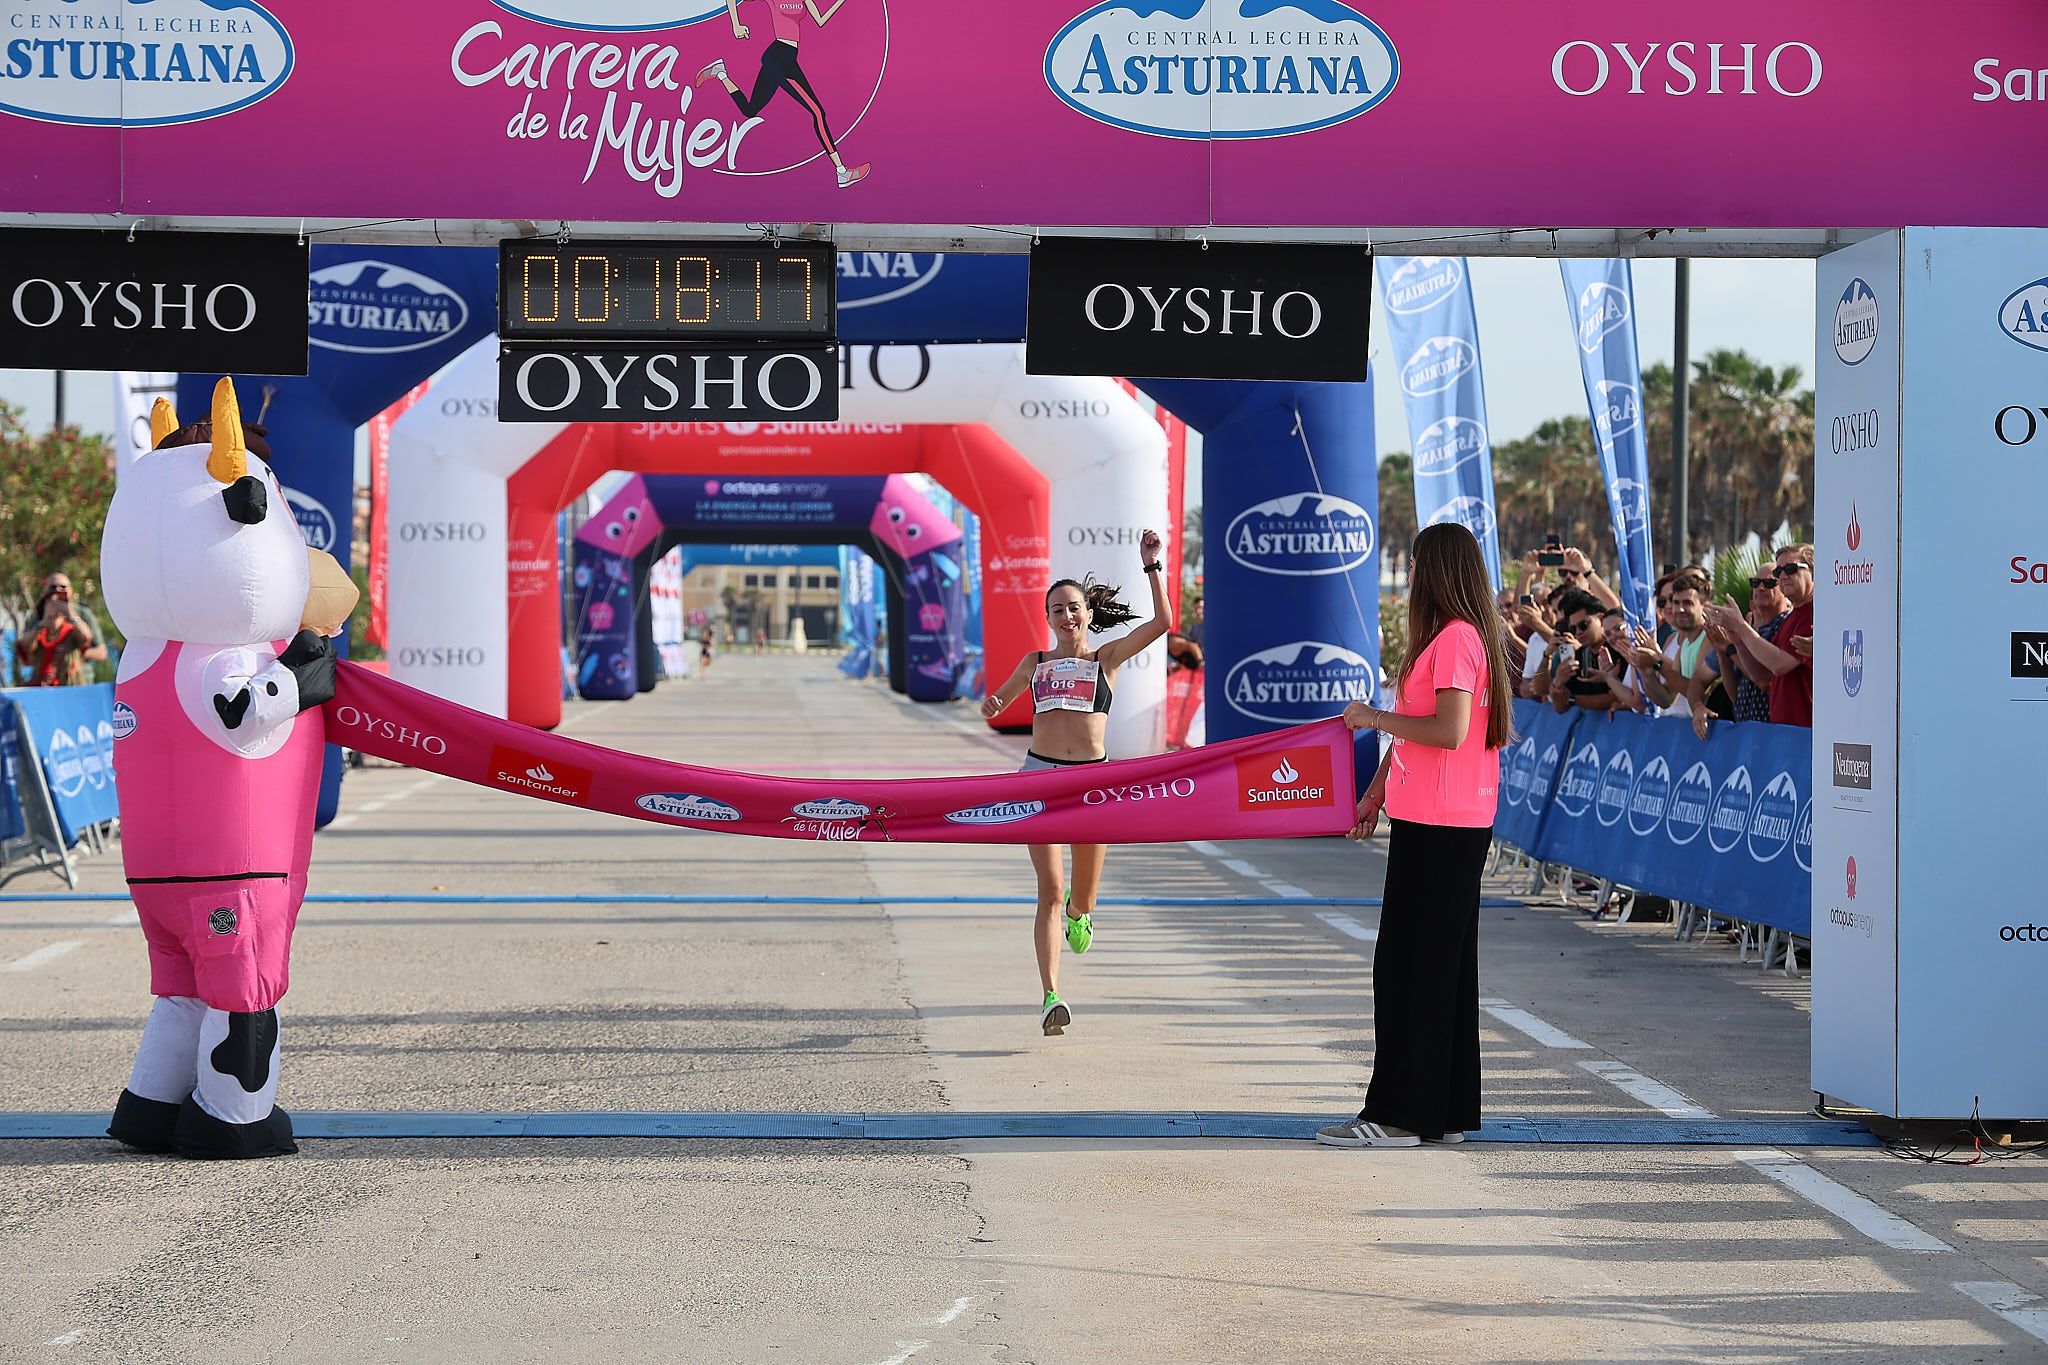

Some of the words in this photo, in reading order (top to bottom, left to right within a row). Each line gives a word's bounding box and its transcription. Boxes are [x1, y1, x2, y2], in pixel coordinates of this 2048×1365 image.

[10, 13, 124, 31] CENTRAL
[138, 17, 253, 34] LECHERA
[1127, 30, 1238, 46] CENTRAL
[1249, 30, 1361, 46] LECHERA
[0, 37, 266, 84] STURIANA
[450, 20, 680, 91] Carrera
[1071, 33, 1373, 95] ASTURIANA
[1551, 40, 1823, 96] OYSHO
[506, 92, 549, 140] de
[558, 91, 589, 141] la
[581, 87, 765, 198] Mujer
[522, 255, 812, 323] 00:18:17
[12, 278, 258, 333] OYSHO
[309, 301, 450, 333] STURIANA
[1084, 283, 1322, 339] OYSHO
[1836, 315, 1876, 347] ASTURIANA
[515, 352, 822, 412] OYSHO
[1020, 400, 1110, 419] OYSHO
[1831, 409, 1879, 455] OYSHO
[400, 522, 487, 543] OYSHO
[1068, 526, 1144, 546] OYSH
[1236, 523, 1368, 555] ASTURIANA
[1834, 557, 1874, 587] Santander
[399, 646, 486, 668] OYSHO
[1051, 680, 1076, 689] 016
[1235, 671, 1367, 703] ASTURIANA
[336, 705, 447, 755] OYSHO
[1835, 751, 1869, 784] Neutrogena
[497, 771, 578, 797] Santander
[1083, 777, 1196, 805] OYSHO
[1247, 785, 1324, 803] Santander
[643, 798, 733, 820] ASTURIANA
[797, 804, 864, 816] ASTURIANA
[793, 821, 806, 832] de
[808, 821, 817, 832] la
[816, 821, 867, 840] Mujer
